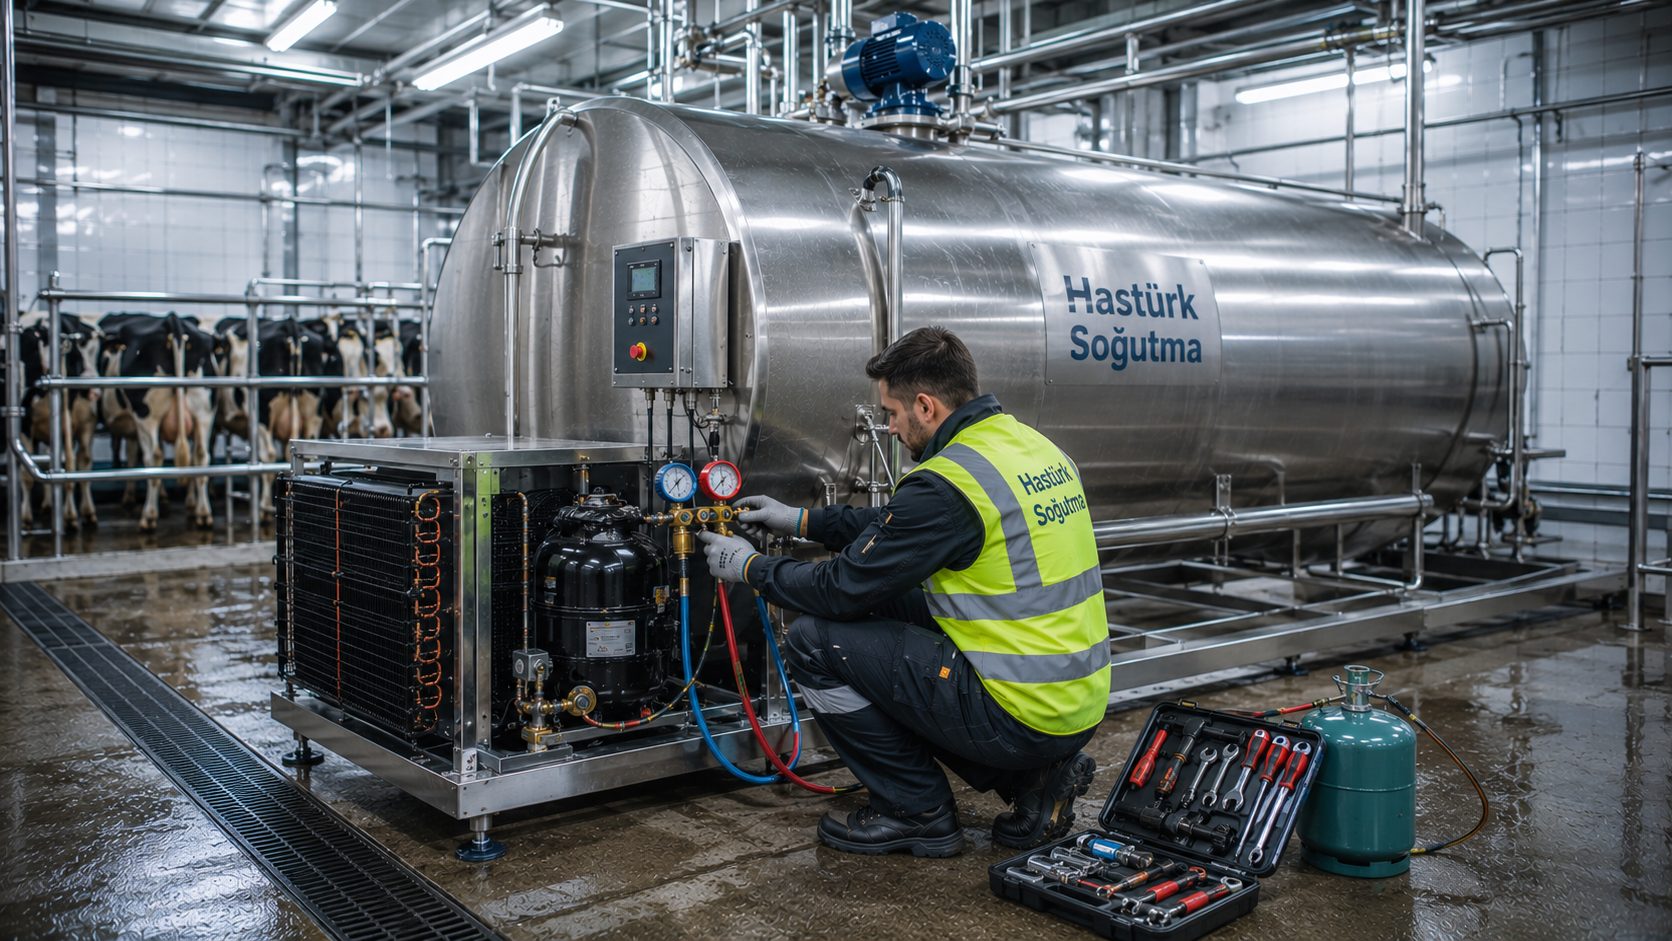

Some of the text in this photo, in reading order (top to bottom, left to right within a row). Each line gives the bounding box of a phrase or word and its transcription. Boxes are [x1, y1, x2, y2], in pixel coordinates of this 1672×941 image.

[1063, 275, 1199, 320] Hastürk
[1070, 324, 1202, 372] Soğutma
[1017, 462, 1073, 496] Hastürk
[1033, 494, 1086, 526] Soğutma
